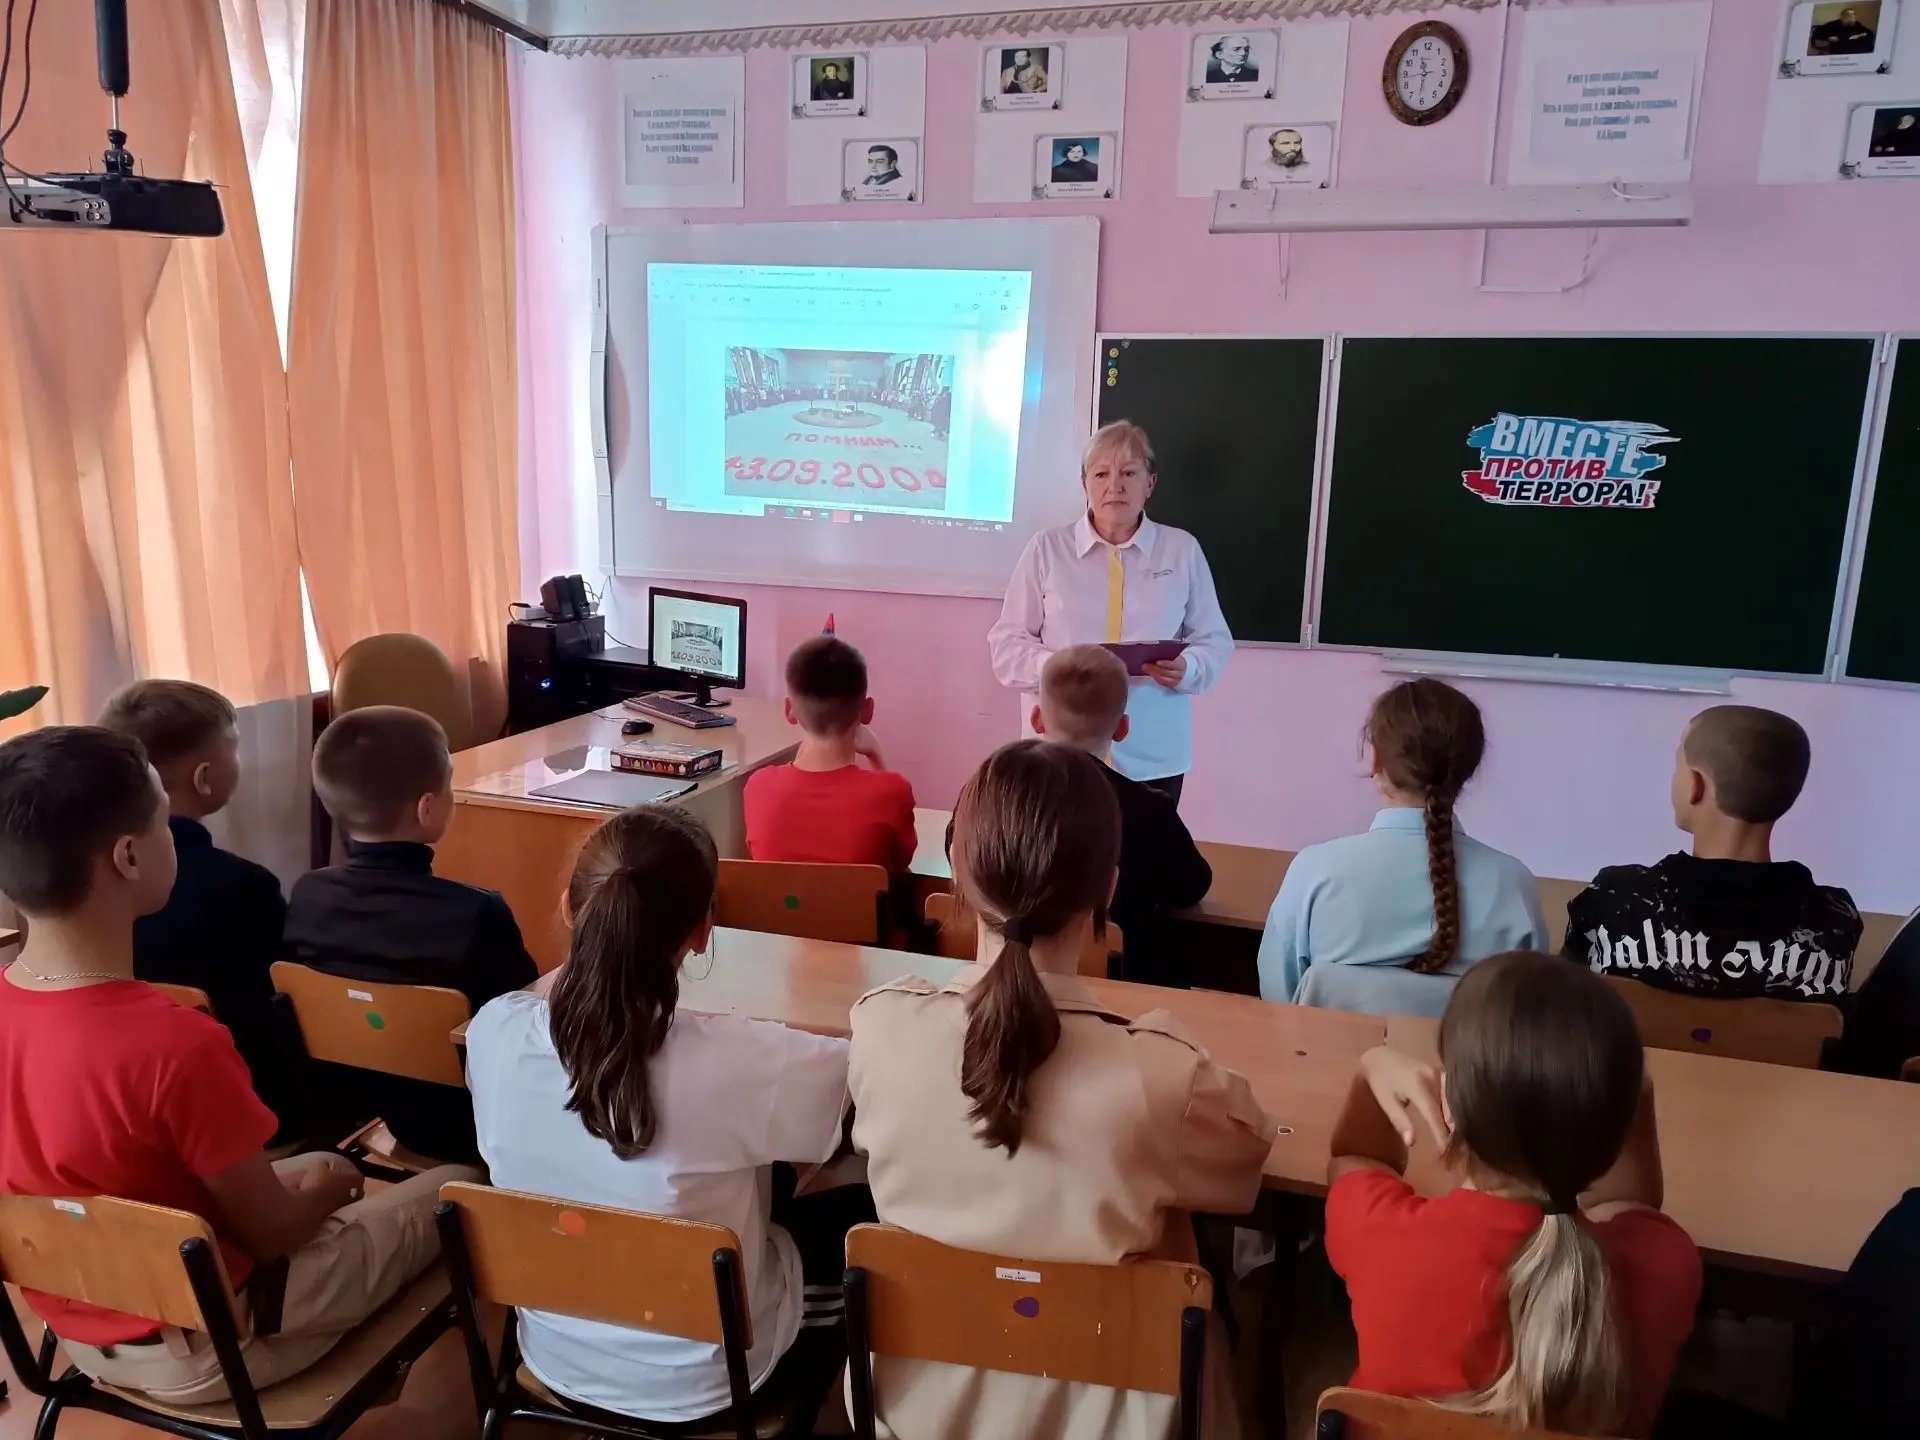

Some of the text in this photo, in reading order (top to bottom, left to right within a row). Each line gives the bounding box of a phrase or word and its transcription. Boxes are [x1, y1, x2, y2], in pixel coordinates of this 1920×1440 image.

[1424, 42, 1432, 50] 12
[1405, 59, 1413, 67] 10
[1489, 413, 1647, 474] ВМЕСТЕ
[1483, 457, 1608, 480] ПРОТИВ
[1499, 480, 1646, 504] ТЕРРОРА!
